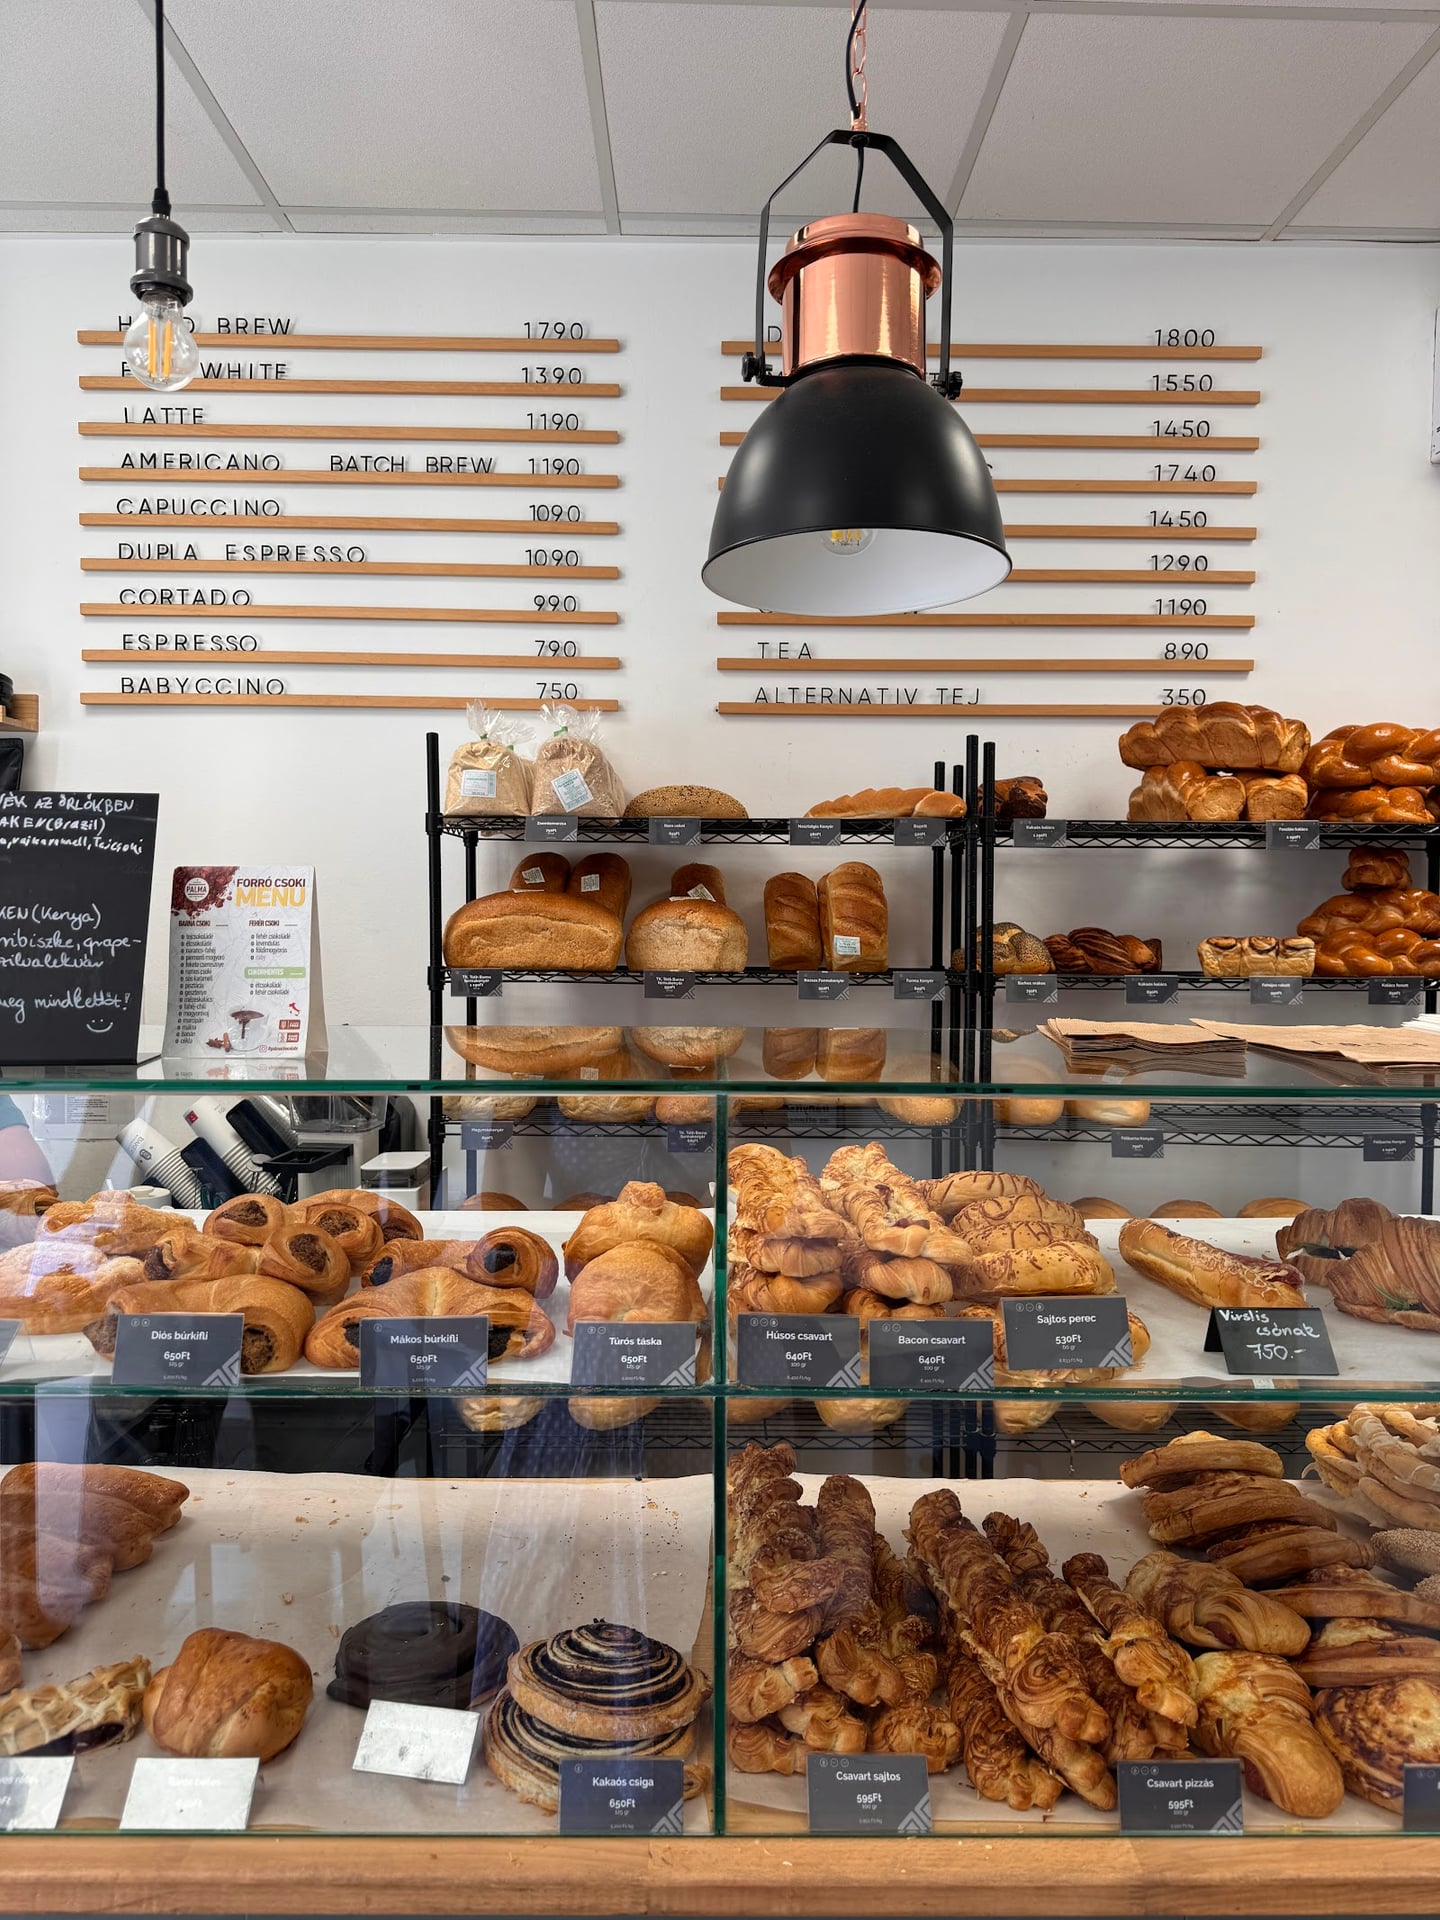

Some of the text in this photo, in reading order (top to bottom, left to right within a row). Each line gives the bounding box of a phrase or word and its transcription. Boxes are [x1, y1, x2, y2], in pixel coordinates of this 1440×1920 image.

[217, 317, 291, 336] BREW
[523, 321, 583, 341] 1790
[1154, 328, 1215, 349] 1800
[200, 362, 582, 385] WHITE 1390
[1152, 374, 1213, 392] 1550
[124, 407, 579, 432] LATTE 1190
[1153, 420, 1210, 438] 1450
[121, 452, 580, 476] AMERICANO BATCH BREW 1190
[1154, 464, 1216, 483] 1740
[116, 498, 581, 523] CAPUCCINO 1090
[1150, 510, 1207, 528] 1450
[118, 543, 579, 567] DUPLA ESPRESSO 1090
[1151, 554, 1208, 572] 1290
[119, 588, 577, 613] CORTADO 990
[1155, 598, 1207, 616] 1190
[122, 634, 577, 658] ESPRESSO 790
[757, 642, 1209, 661] TEA 890
[121, 677, 578, 700] BABYCCINO 750
[754, 687, 1208, 707] ALTERNATIV TEJ 350
[34, 796, 53, 809] AZ
[236, 875, 307, 888] FORRÓ CSOKI
[234, 886, 307, 908] MENU
[1036, 1314, 1097, 1326] Sajtos perec
[1218, 1309, 1270, 1324] Virslis
[151, 1330, 209, 1341] Diós búrkifli
[390, 1333, 460, 1345] Mákos búrkifli
[608, 1336, 663, 1346] Túrós táska
[766, 1330, 833, 1342] Húsos csavart
[898, 1335, 967, 1345] Bacon csavart
[1055, 1334, 1083, 1345] 530Ft
[163, 1351, 191, 1361] 650Ft
[410, 1354, 438, 1365] 650Ft
[620, 1354, 648, 1364] 650Ft
[785, 1351, 813, 1361] 640Ft
[918, 1355, 946, 1365] 640Ft
[592, 1776, 655, 1789] Kakaós csiga
[835, 1770, 902, 1783] Csavart sajtos
[1146, 1778, 1215, 1790] Csavart pizzás
[609, 1798, 636, 1808] 650Ft
[856, 1792, 883, 1804] 595Ft
[1168, 1799, 1194, 1810] 595Ft
